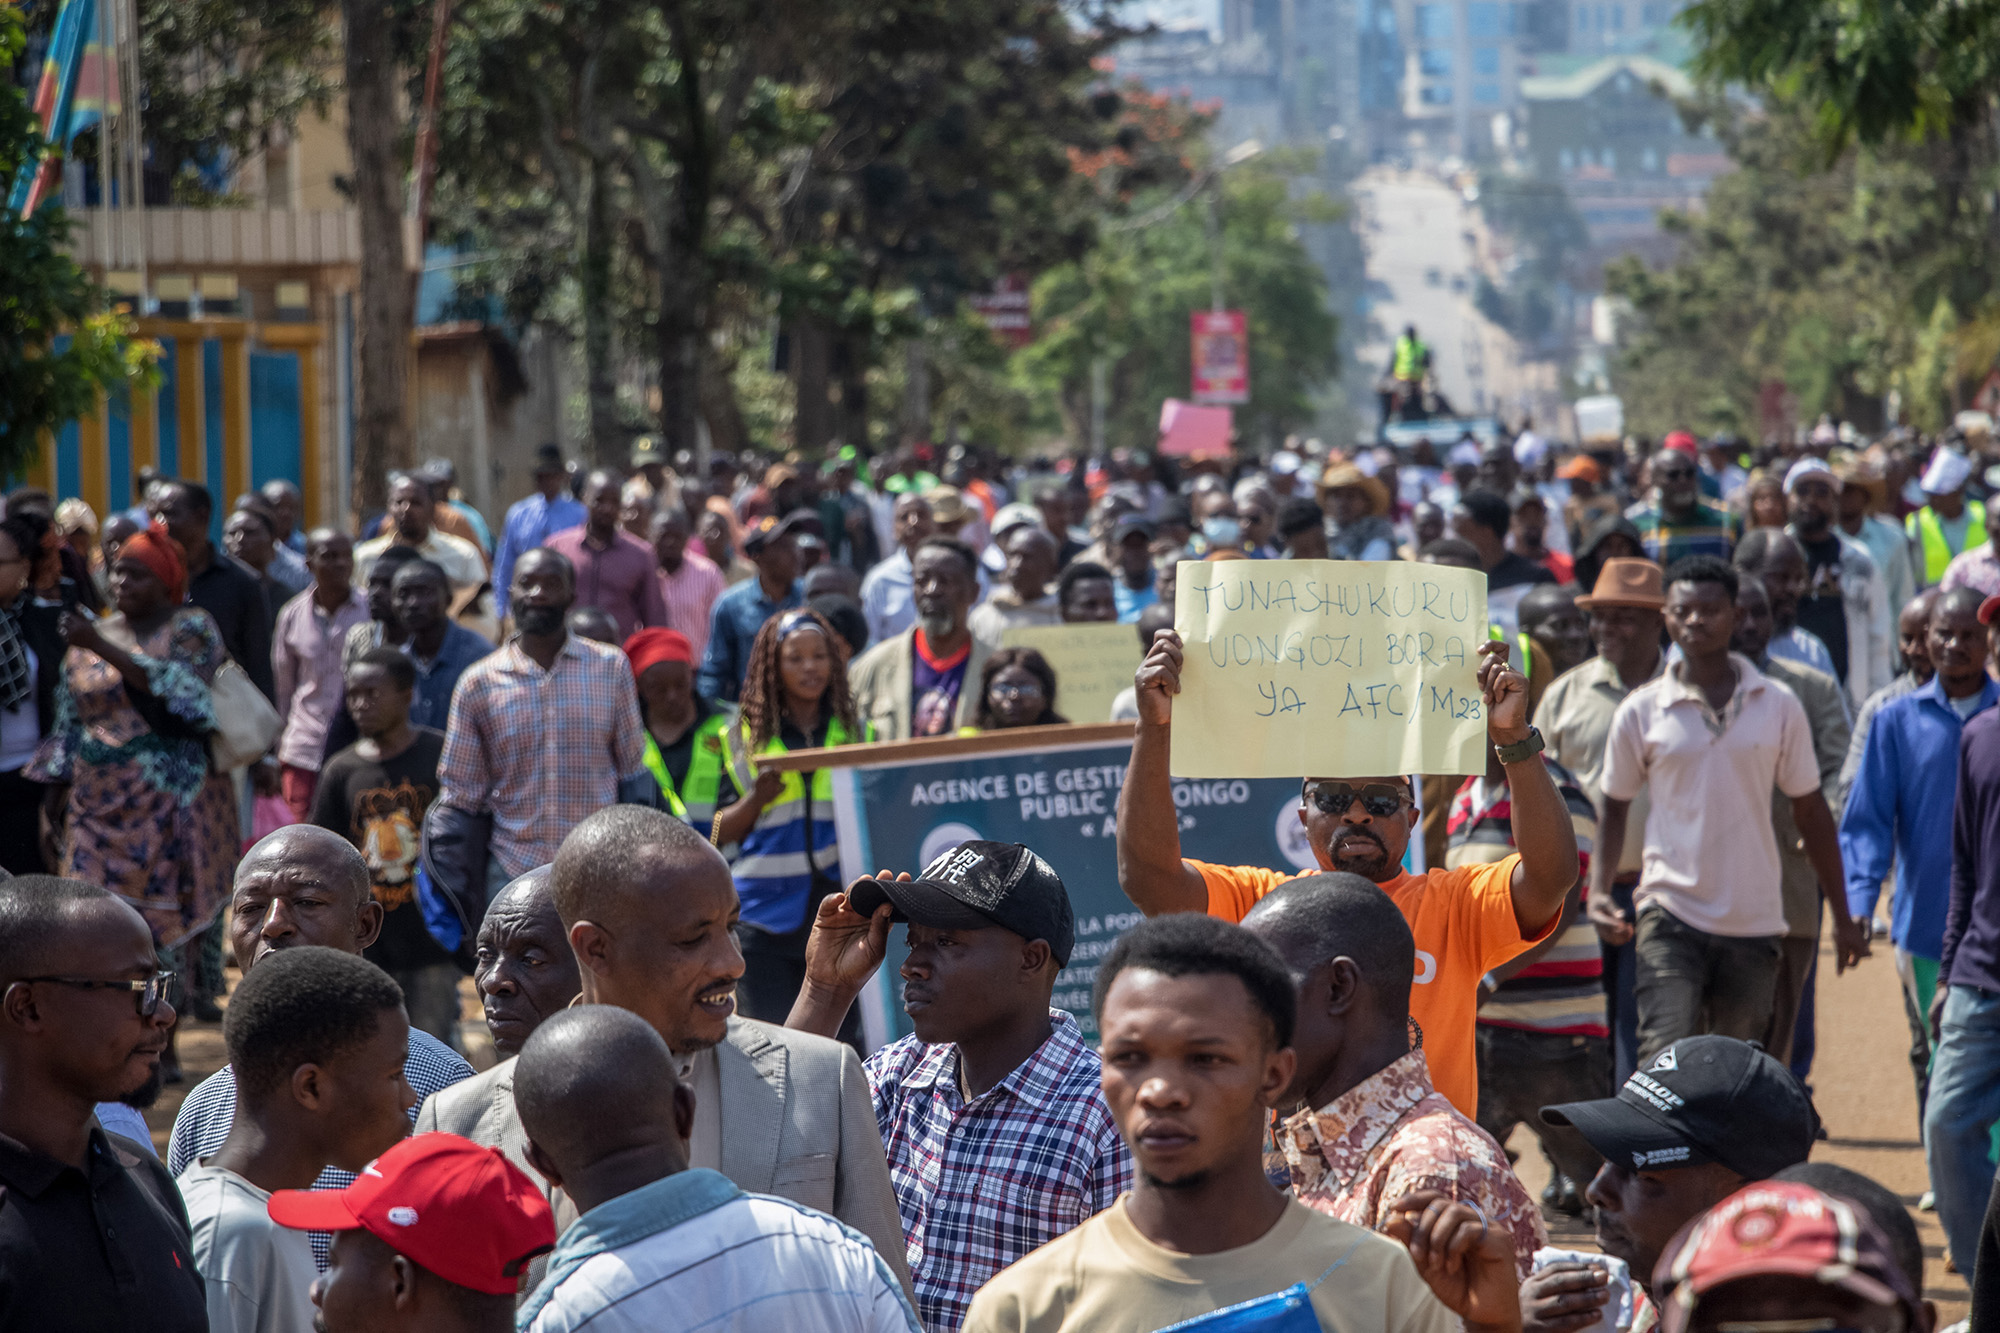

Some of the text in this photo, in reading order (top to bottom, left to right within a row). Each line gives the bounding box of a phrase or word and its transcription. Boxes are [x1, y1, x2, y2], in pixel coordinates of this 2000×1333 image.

[1193, 579, 1469, 622] TUNASHUKURU
[1209, 631, 1465, 670] UONGOZI BORA
[1255, 681, 1306, 717] YA
[911, 764, 1128, 806] AGENCE DE GESTI
[1020, 790, 1108, 821] PUBLIC
[1172, 780, 1250, 808] ONGO
[1078, 912, 1145, 936] LA POP
